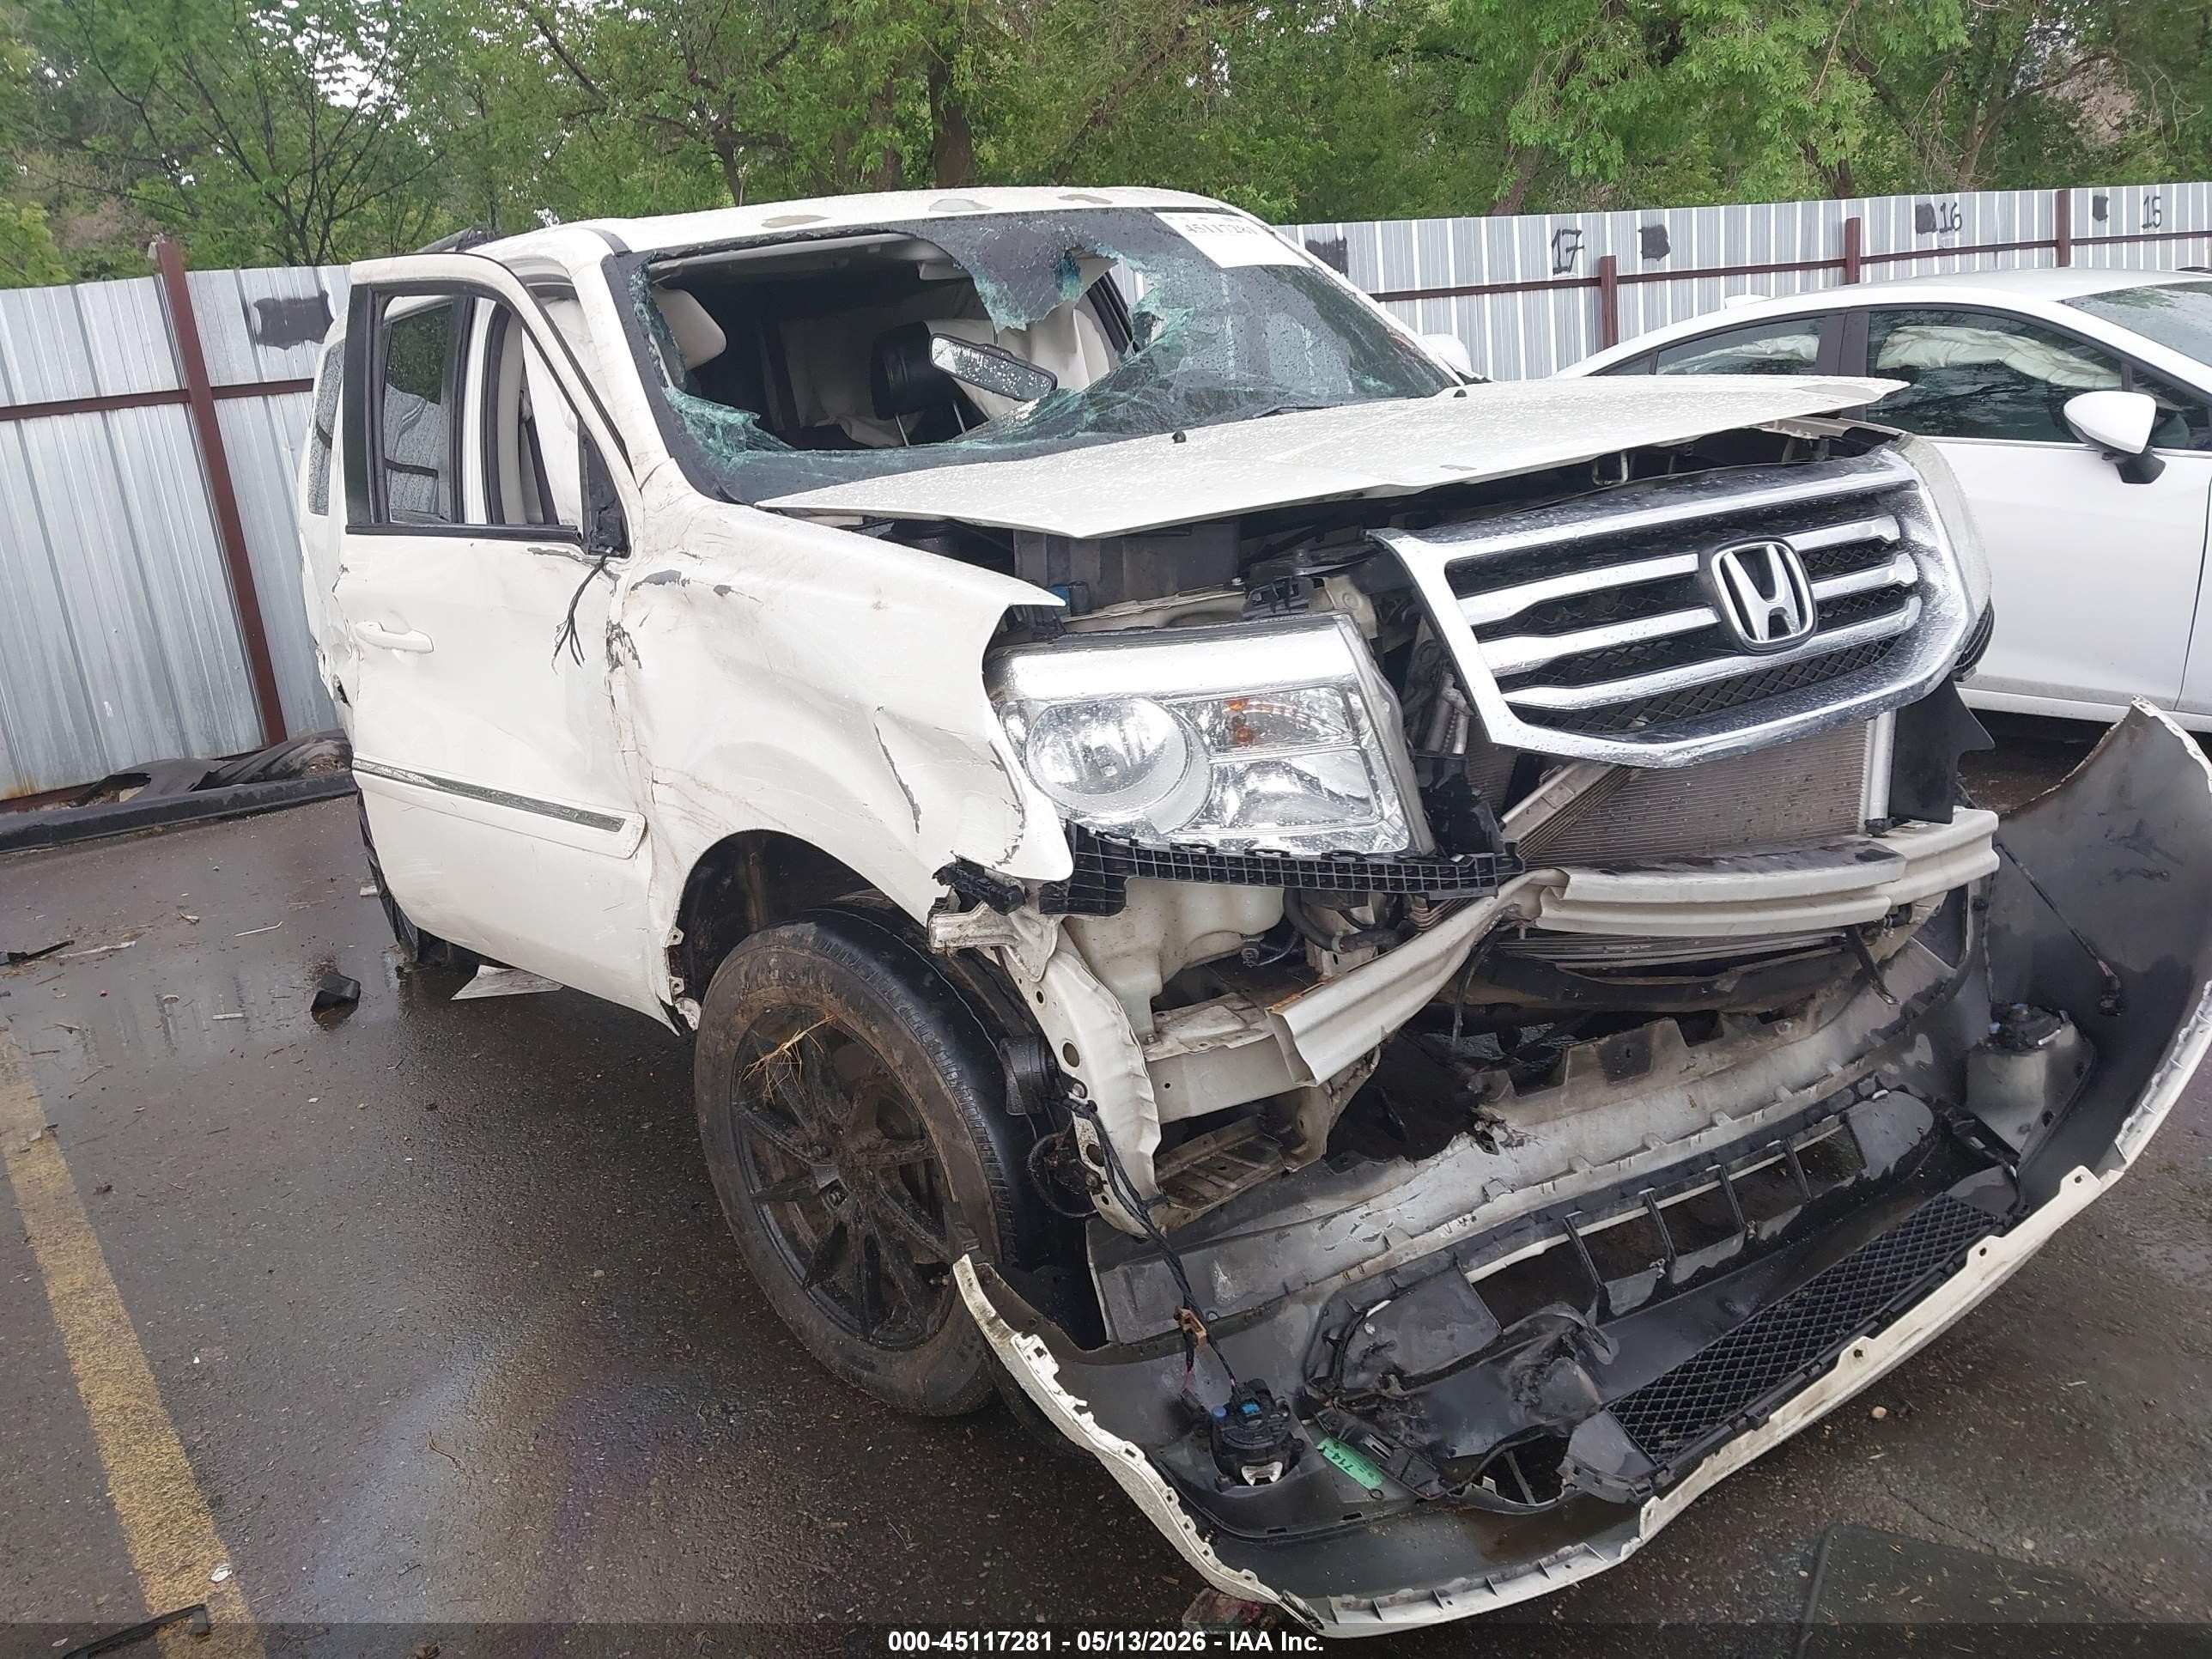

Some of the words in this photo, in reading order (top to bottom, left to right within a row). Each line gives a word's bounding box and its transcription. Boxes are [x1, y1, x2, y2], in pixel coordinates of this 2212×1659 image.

[1939, 202, 1963, 234] 16
[2142, 195, 2162, 229] 15
[1551, 228, 1584, 276] 17
